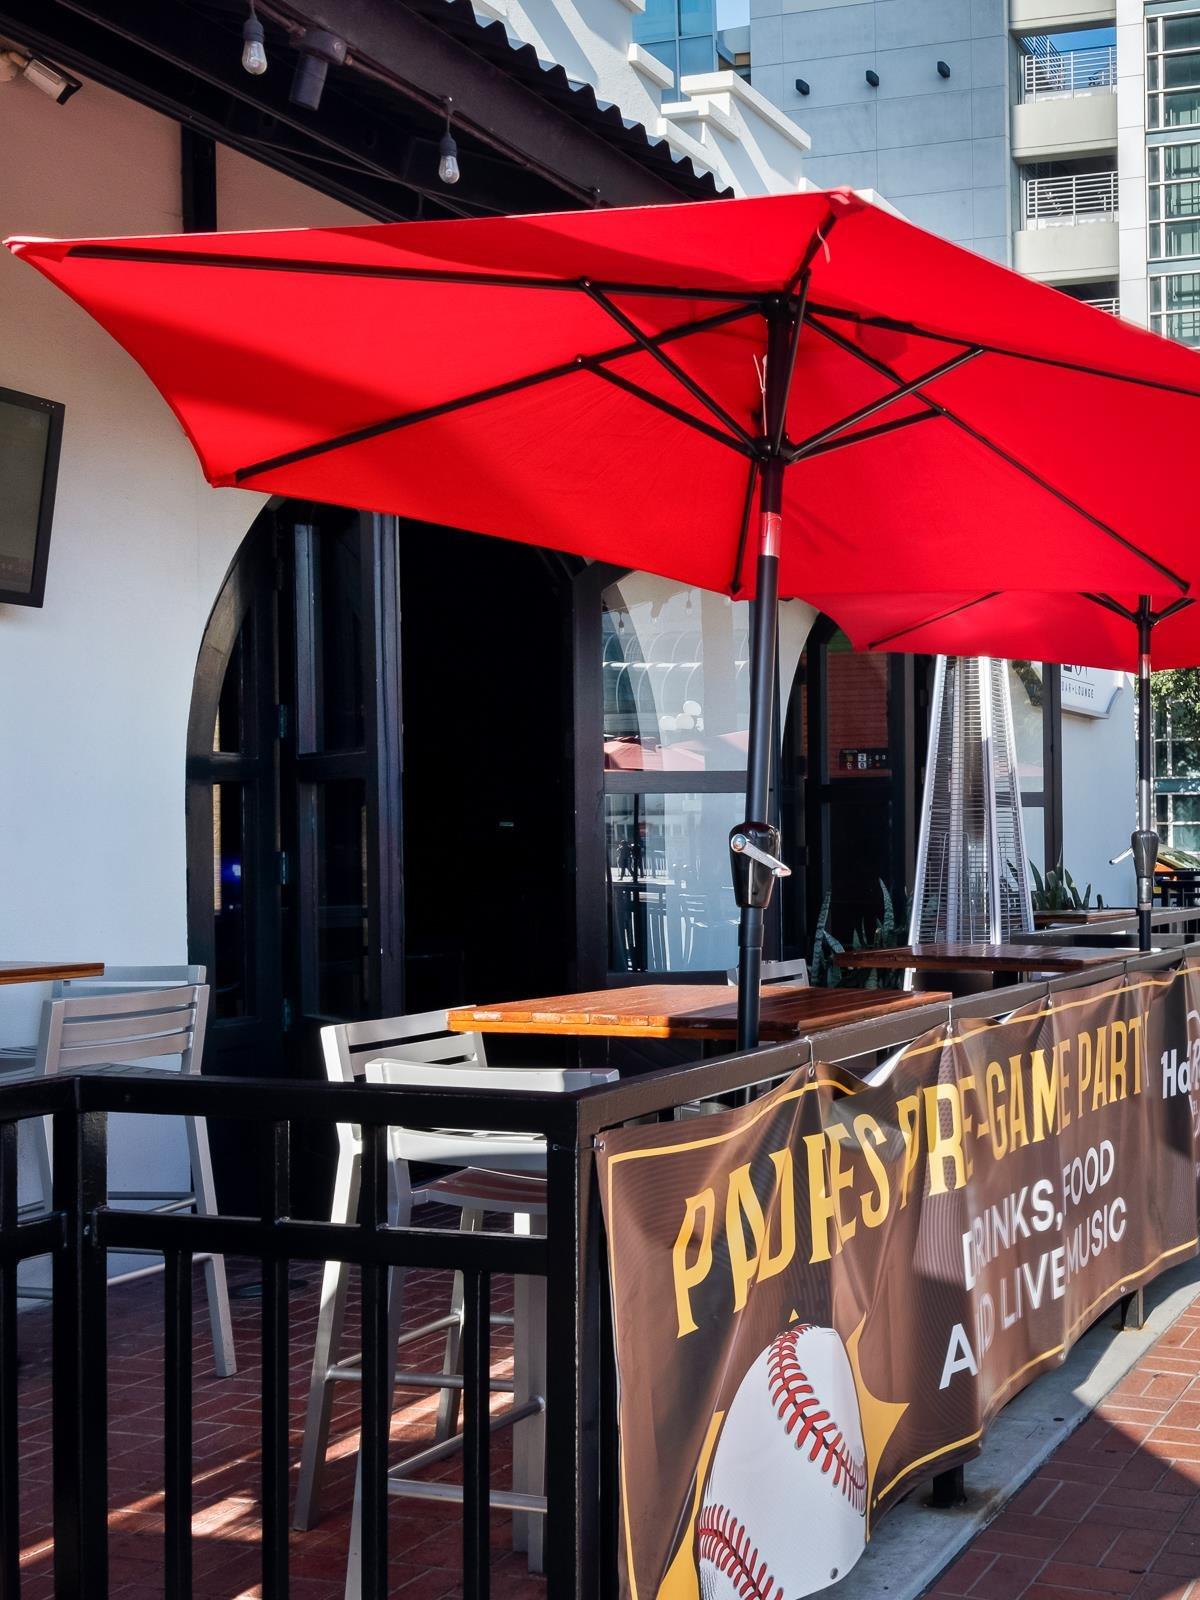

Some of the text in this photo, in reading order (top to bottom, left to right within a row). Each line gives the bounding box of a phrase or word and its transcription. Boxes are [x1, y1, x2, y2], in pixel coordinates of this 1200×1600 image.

[961, 1138, 1115, 1292] DRINKS, FOOD
[1001, 1245, 1066, 1330] LIVE
[1066, 1196, 1127, 1284] MUSIC
